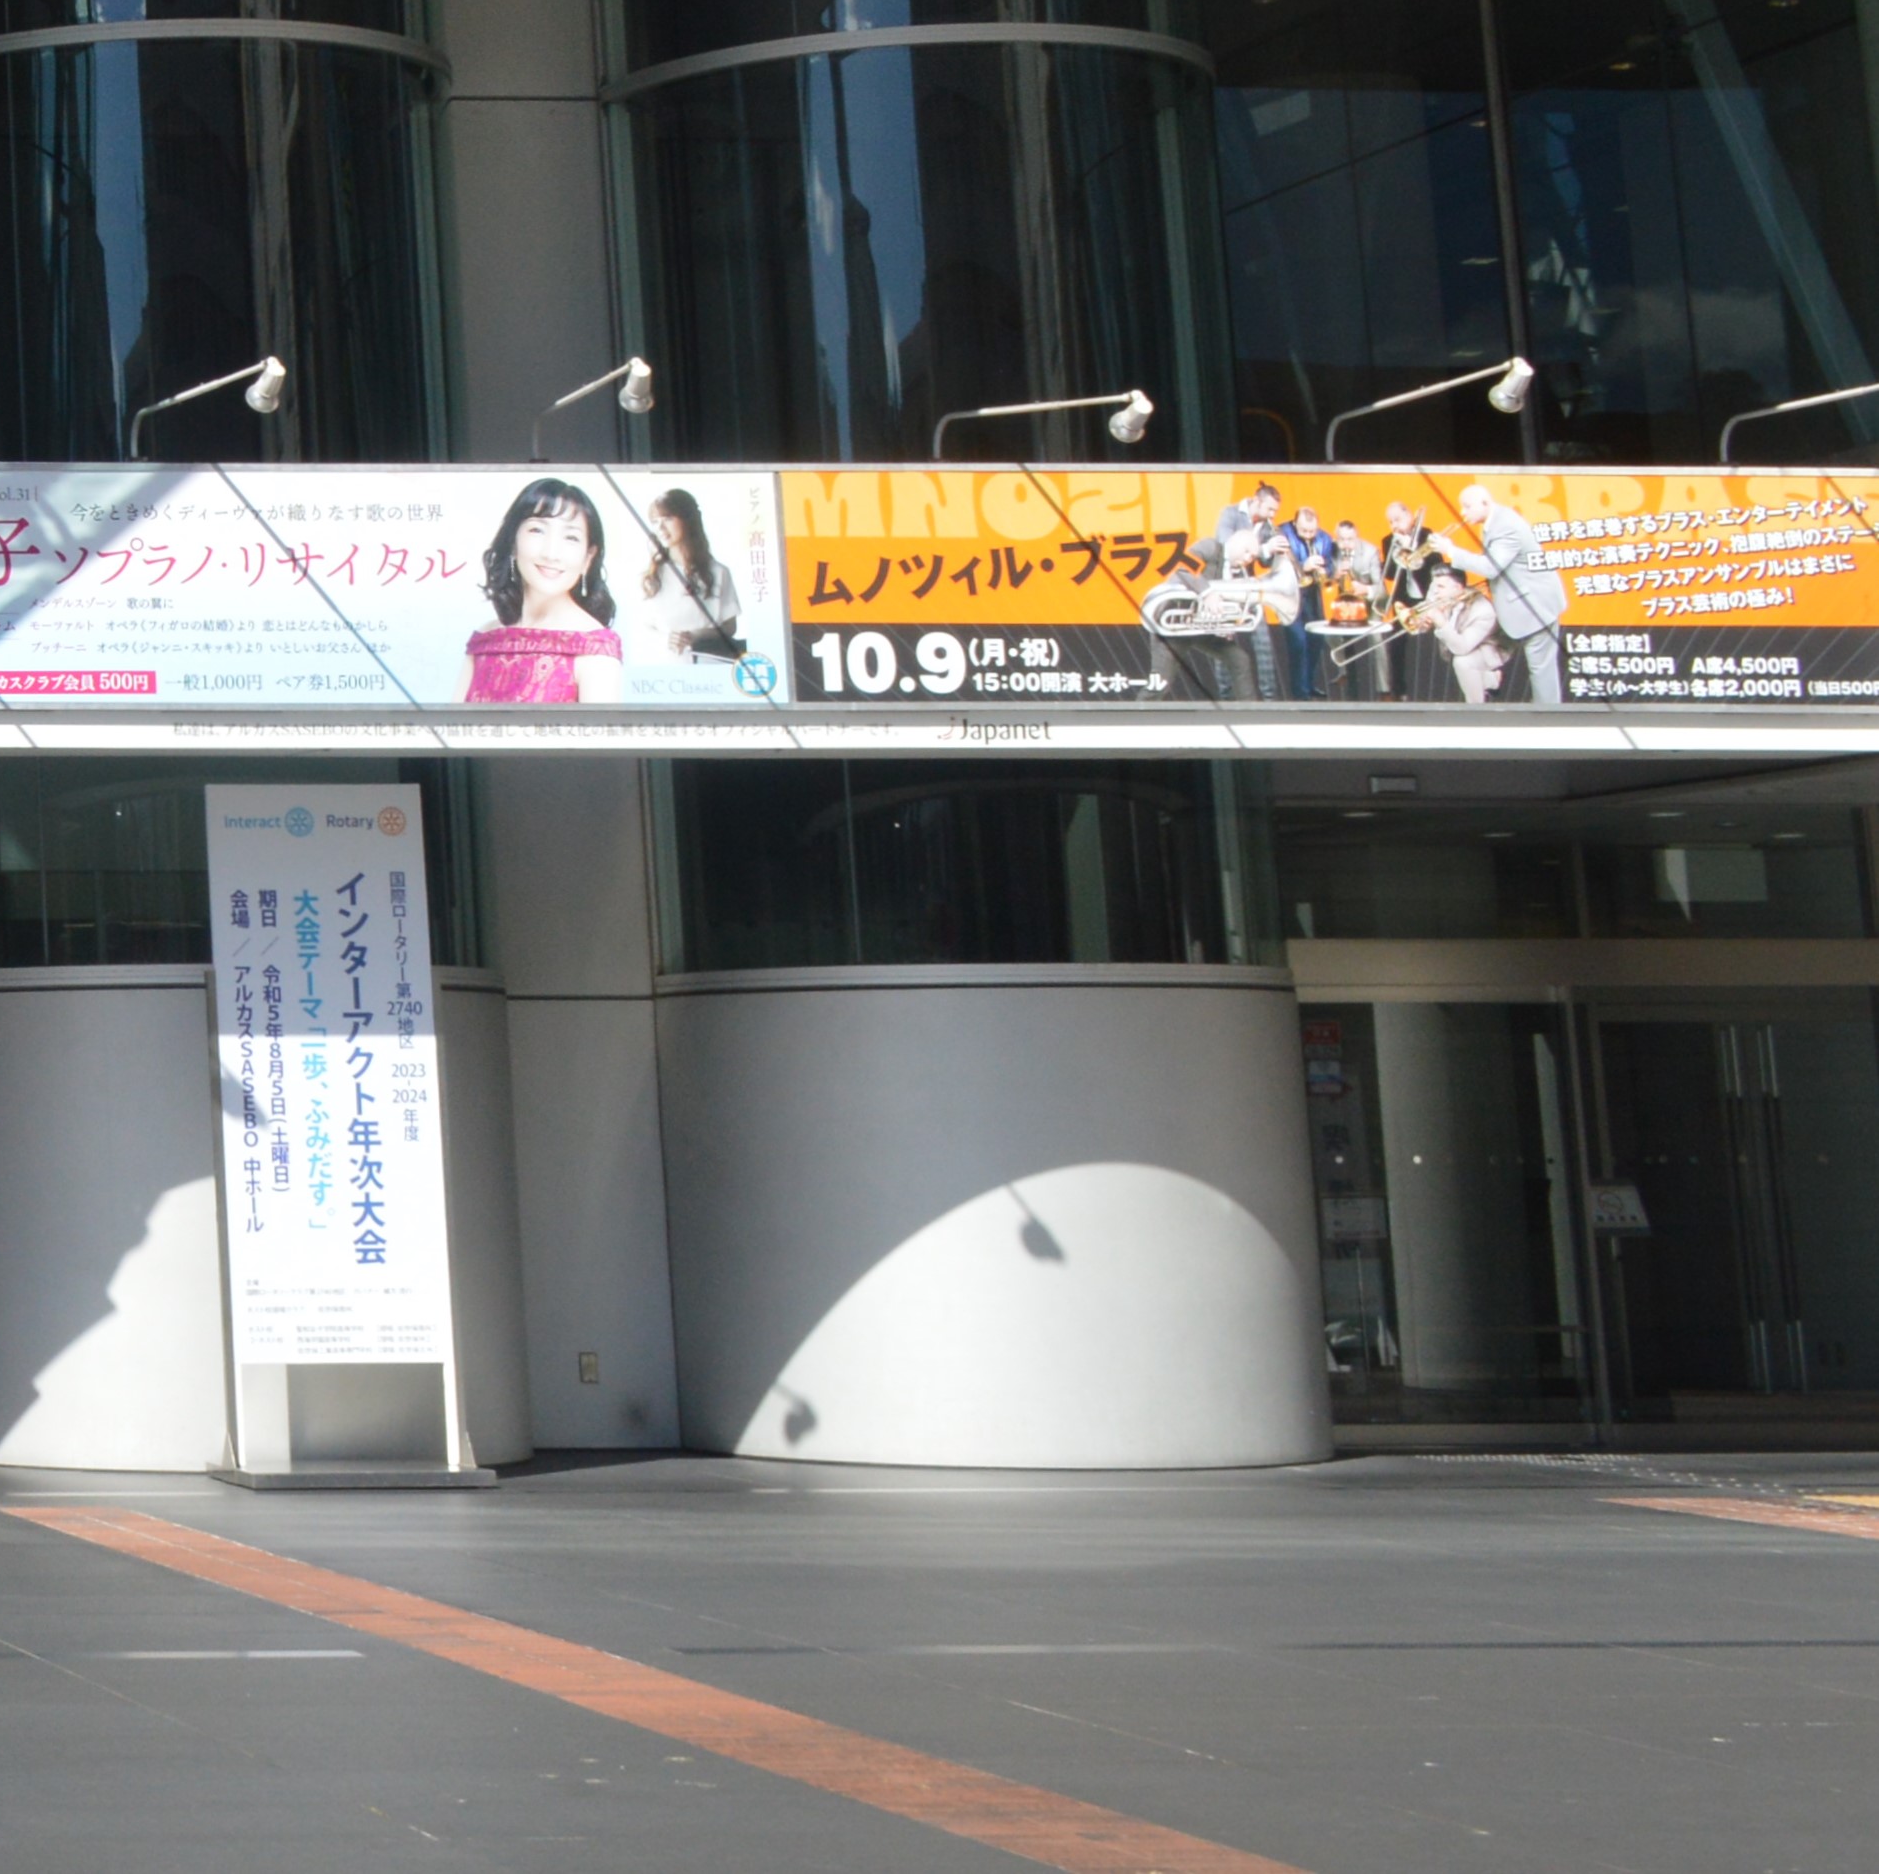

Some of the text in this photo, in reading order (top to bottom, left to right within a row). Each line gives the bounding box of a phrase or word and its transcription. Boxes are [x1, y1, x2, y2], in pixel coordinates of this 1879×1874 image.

[53, 537, 469, 589] ソプラノ・リサイタル
[807, 532, 1203, 607] ムノツィル・ブラス
[1574, 553, 1856, 596] 完璧なブラスアンサンブルはまさに
[98, 673, 150, 692] 500円
[973, 672, 1168, 695] 15:00開演 大ホール
[959, 718, 1052, 745] Japanet
[224, 814, 375, 831] Interact Rotary
[229, 889, 251, 929] 会場
[258, 889, 278, 928] 期日
[336, 872, 387, 1265] インターアクト年次大会
